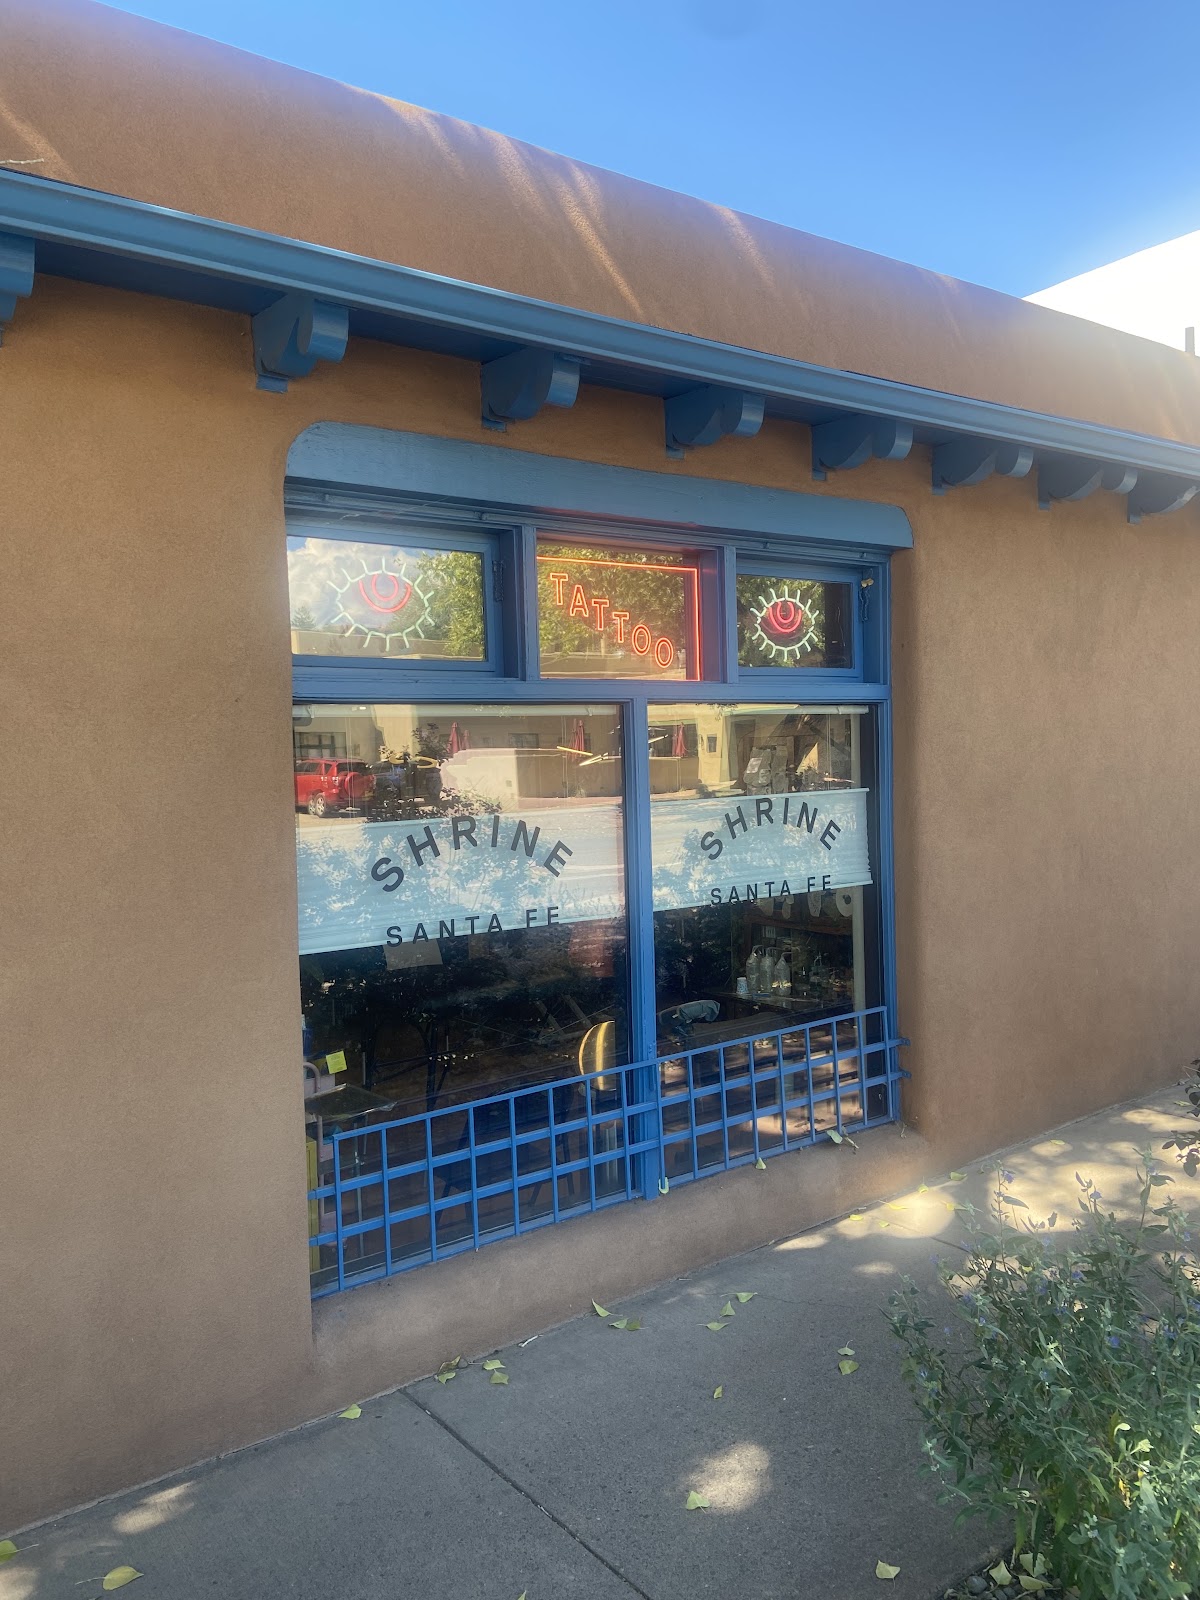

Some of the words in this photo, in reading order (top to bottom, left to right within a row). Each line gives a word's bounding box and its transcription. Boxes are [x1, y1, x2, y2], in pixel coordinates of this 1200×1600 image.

[549, 572, 674, 669] TATTOO
[370, 815, 574, 892] SHRINE
[700, 797, 842, 861] SHRINE
[710, 879, 791, 906] SANTA
[807, 874, 832, 893] FE
[386, 913, 503, 948] SANTA
[526, 906, 560, 928] FE
